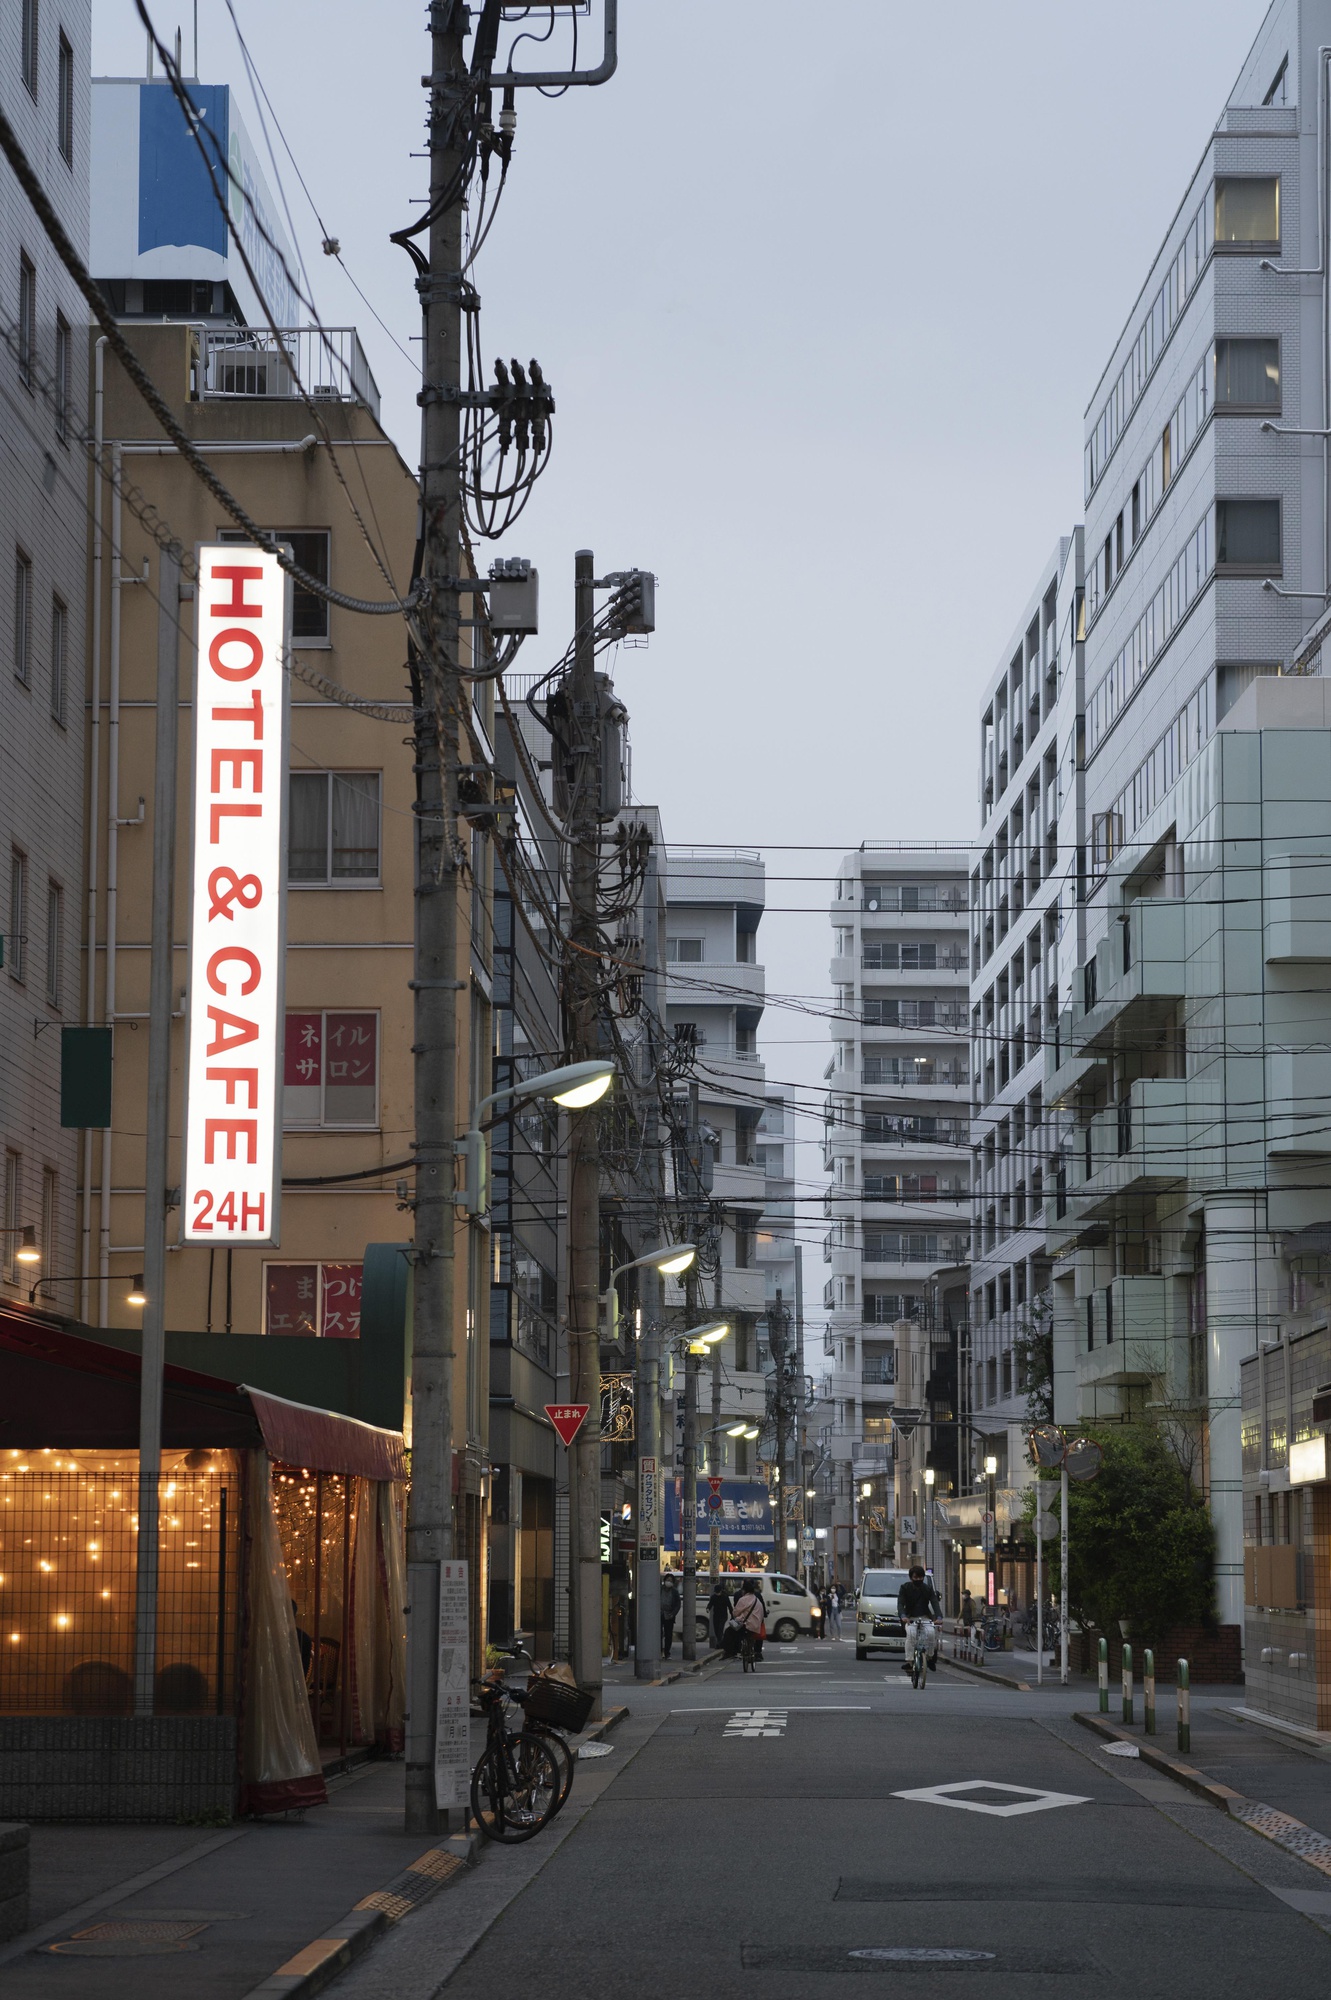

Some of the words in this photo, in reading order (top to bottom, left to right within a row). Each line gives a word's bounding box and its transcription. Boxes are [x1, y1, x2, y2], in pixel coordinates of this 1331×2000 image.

[208, 565, 264, 844] HOTEL
[207, 866, 263, 921] &
[204, 945, 262, 1165] CAFE
[299, 1024, 371, 1048] ネイル
[296, 1058, 371, 1081] サロン
[192, 1189, 266, 1232] 24H
[554, 1409, 581, 1419] 止まれ
[645, 1474, 653, 1518] クラタセブン
